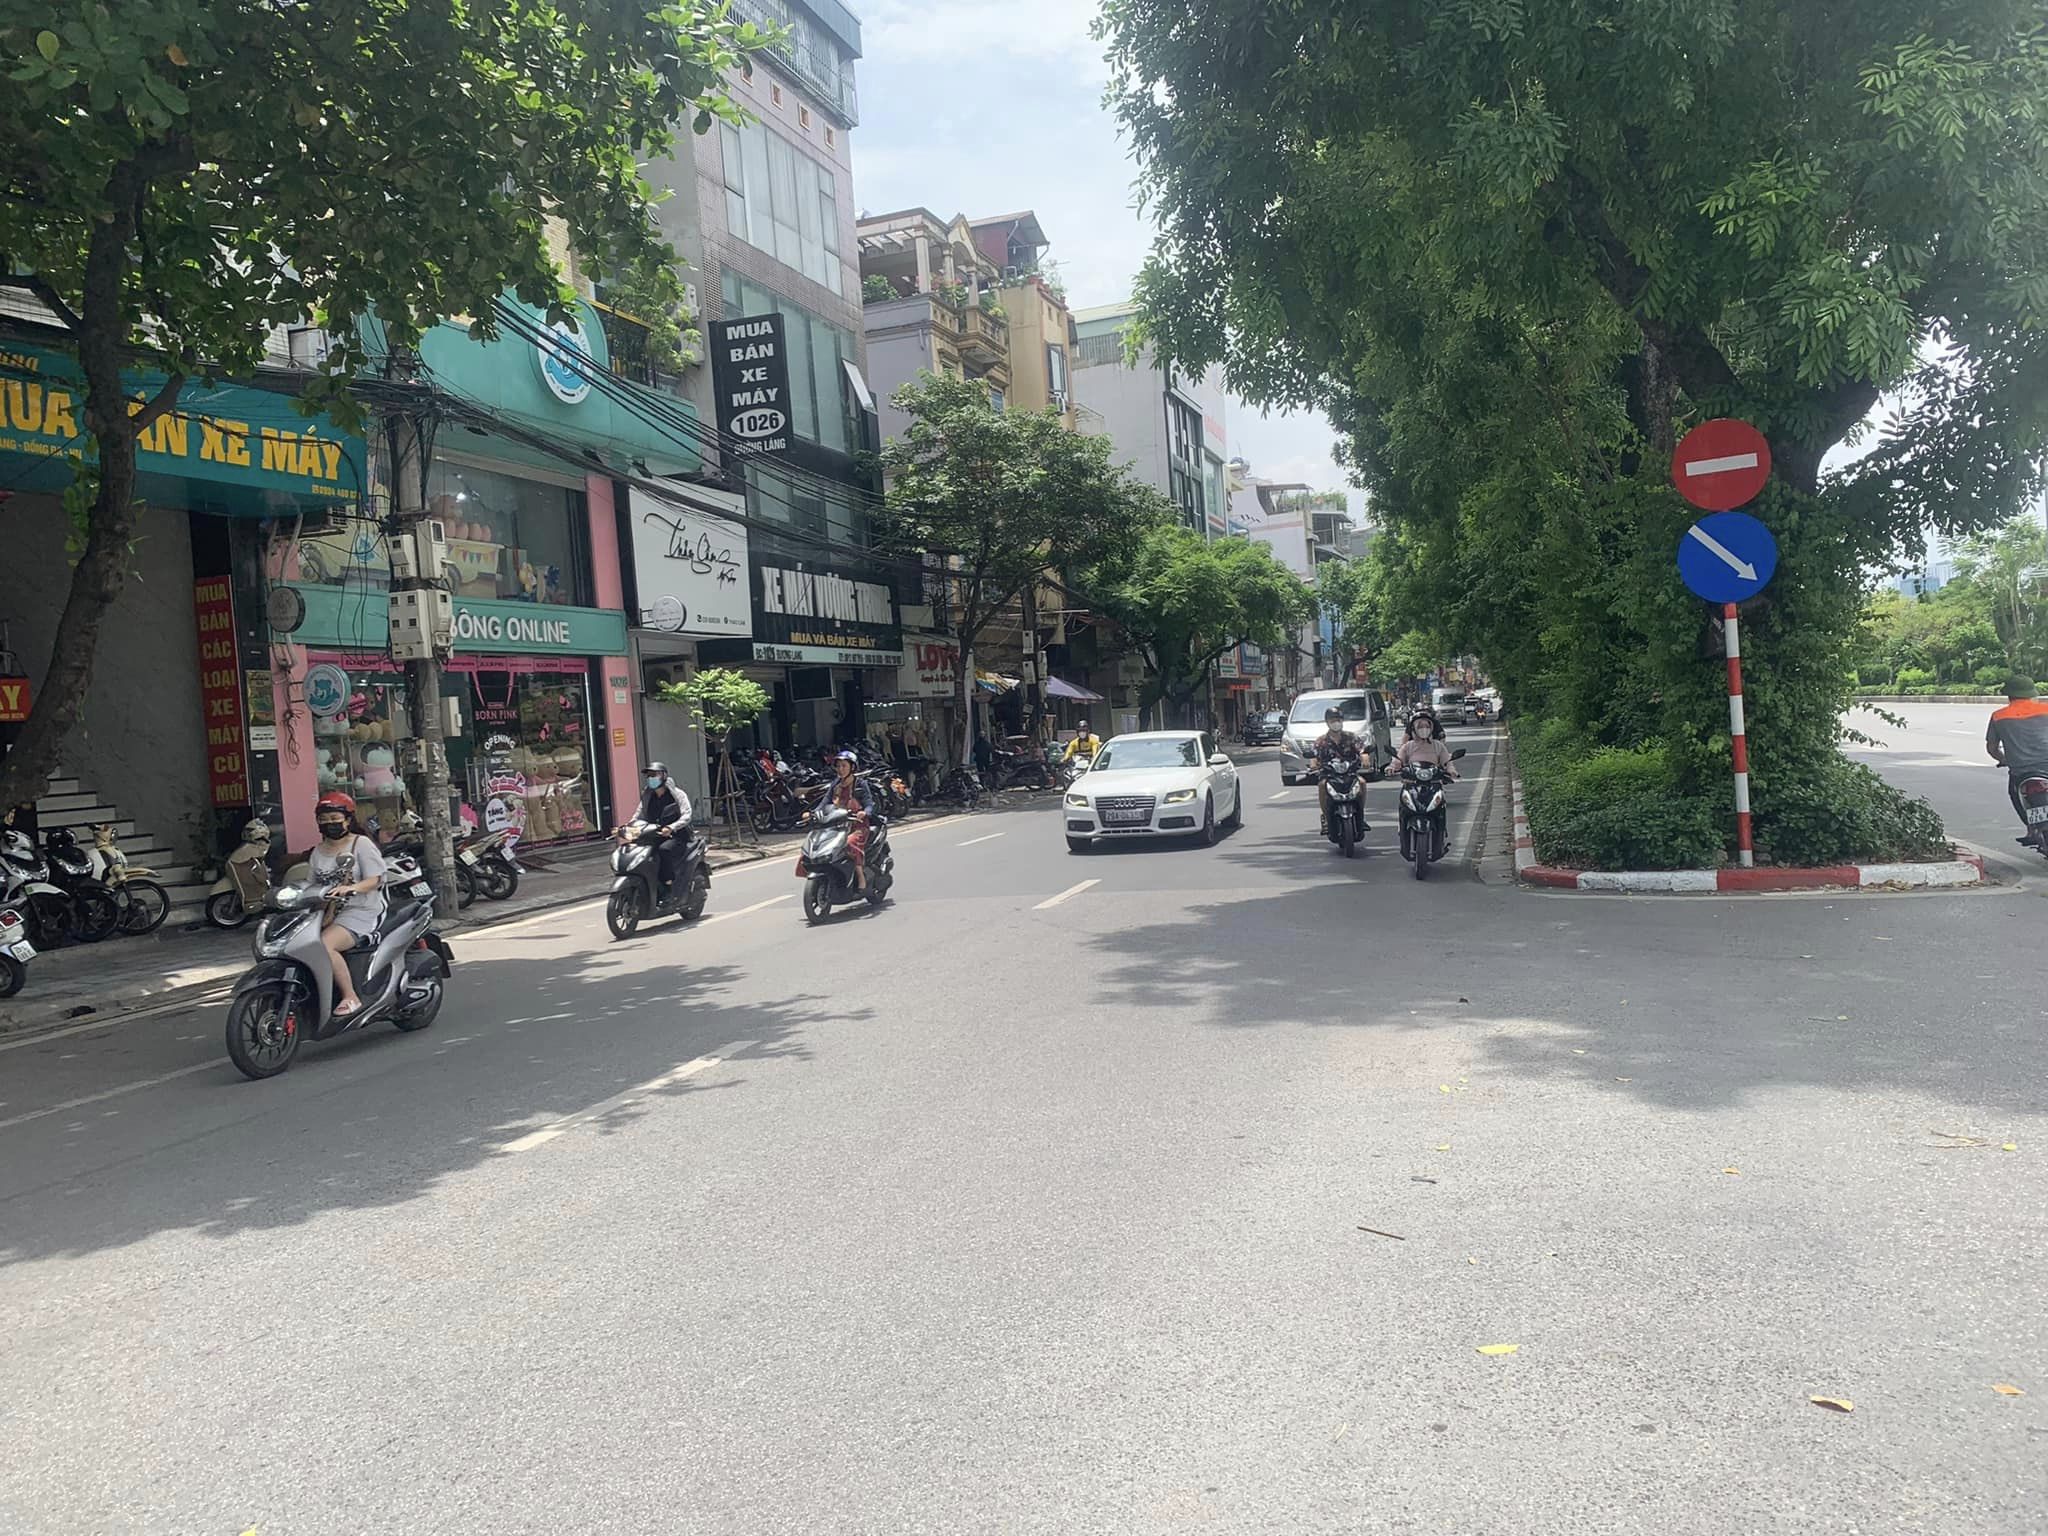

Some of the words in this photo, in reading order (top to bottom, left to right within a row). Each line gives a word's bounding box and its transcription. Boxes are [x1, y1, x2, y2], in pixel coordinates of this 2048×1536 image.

[727, 321, 774, 340] MUA
[730, 343, 774, 362] BÁN
[741, 367, 768, 383] XE
[732, 387, 778, 407] MÁY
[0, 379, 78, 438] UA
[200, 414, 250, 467] XE
[261, 424, 343, 481] MÁY
[736, 413, 780, 434] 1026
[764, 438, 786, 451] LÁNG
[195, 583, 228, 604] MUA
[761, 565, 784, 613] XE
[782, 562, 814, 617] MÁY
[201, 610, 230, 632] BÁN
[507, 617, 571, 644] ONLINE
[202, 639, 232, 660] CÁC
[790, 631, 812, 645] MUA
[826, 633, 847, 647] BÁN
[846, 636, 859, 647] XE
[203, 670, 236, 691] LOẠI
[210, 698, 235, 717] XE
[475, 711, 497, 720] BORN
[208, 723, 240, 745] MÁY
[484, 734, 516, 750] OPENING
[213, 751, 241, 774] CŨ
